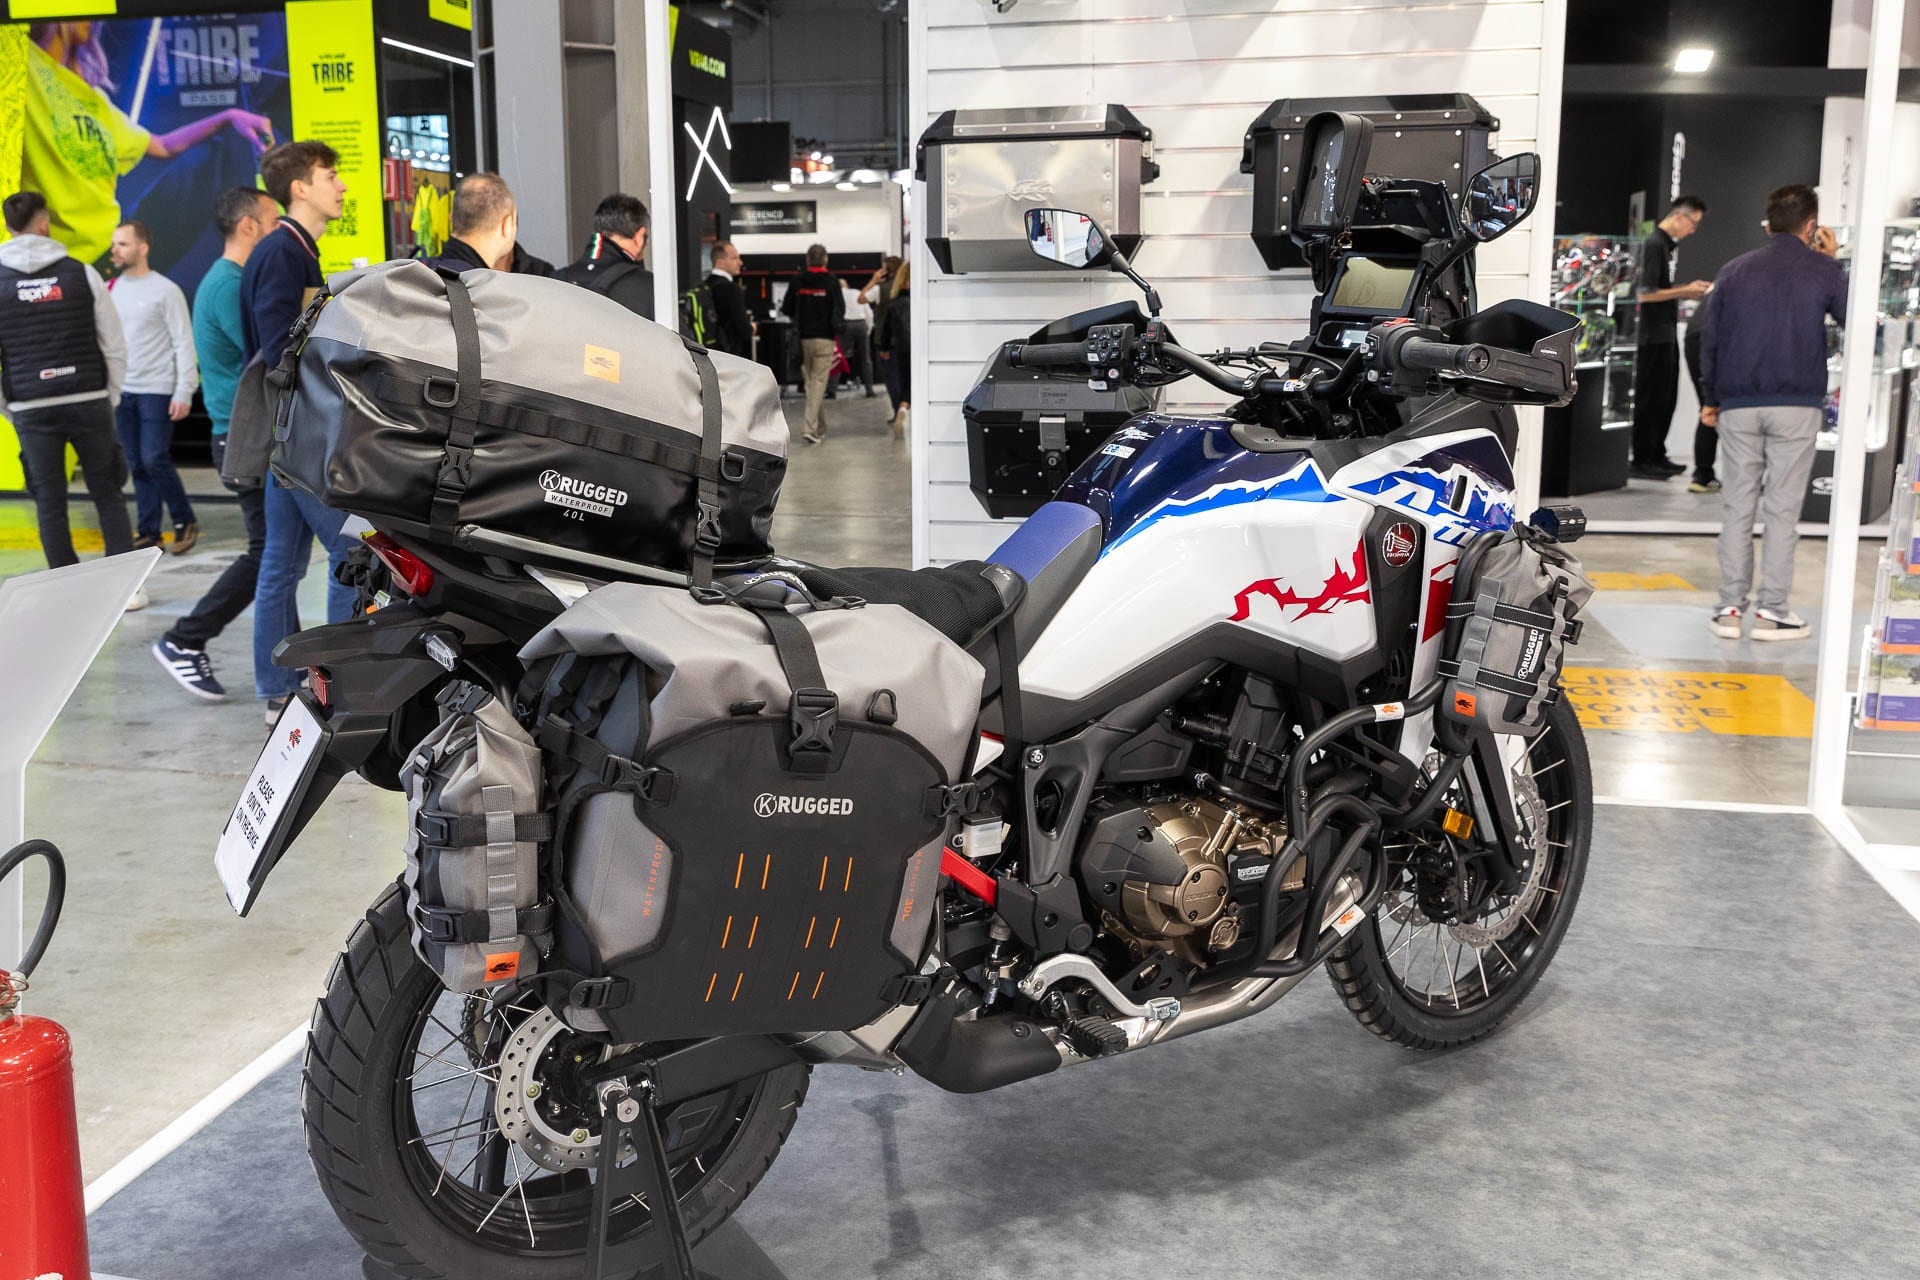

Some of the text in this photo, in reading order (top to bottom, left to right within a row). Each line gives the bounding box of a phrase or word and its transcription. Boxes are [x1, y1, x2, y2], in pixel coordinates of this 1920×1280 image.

[156, 25, 262, 86] TRIBE
[312, 62, 354, 84] TRIBE
[550, 494, 609, 513] WATERPROOF
[563, 509, 585, 522] 40L
[257, 775, 275, 804] PLEASE
[256, 807, 267, 825] SIT
[236, 807, 244, 824] ON
[246, 826, 259, 850] BIKE
